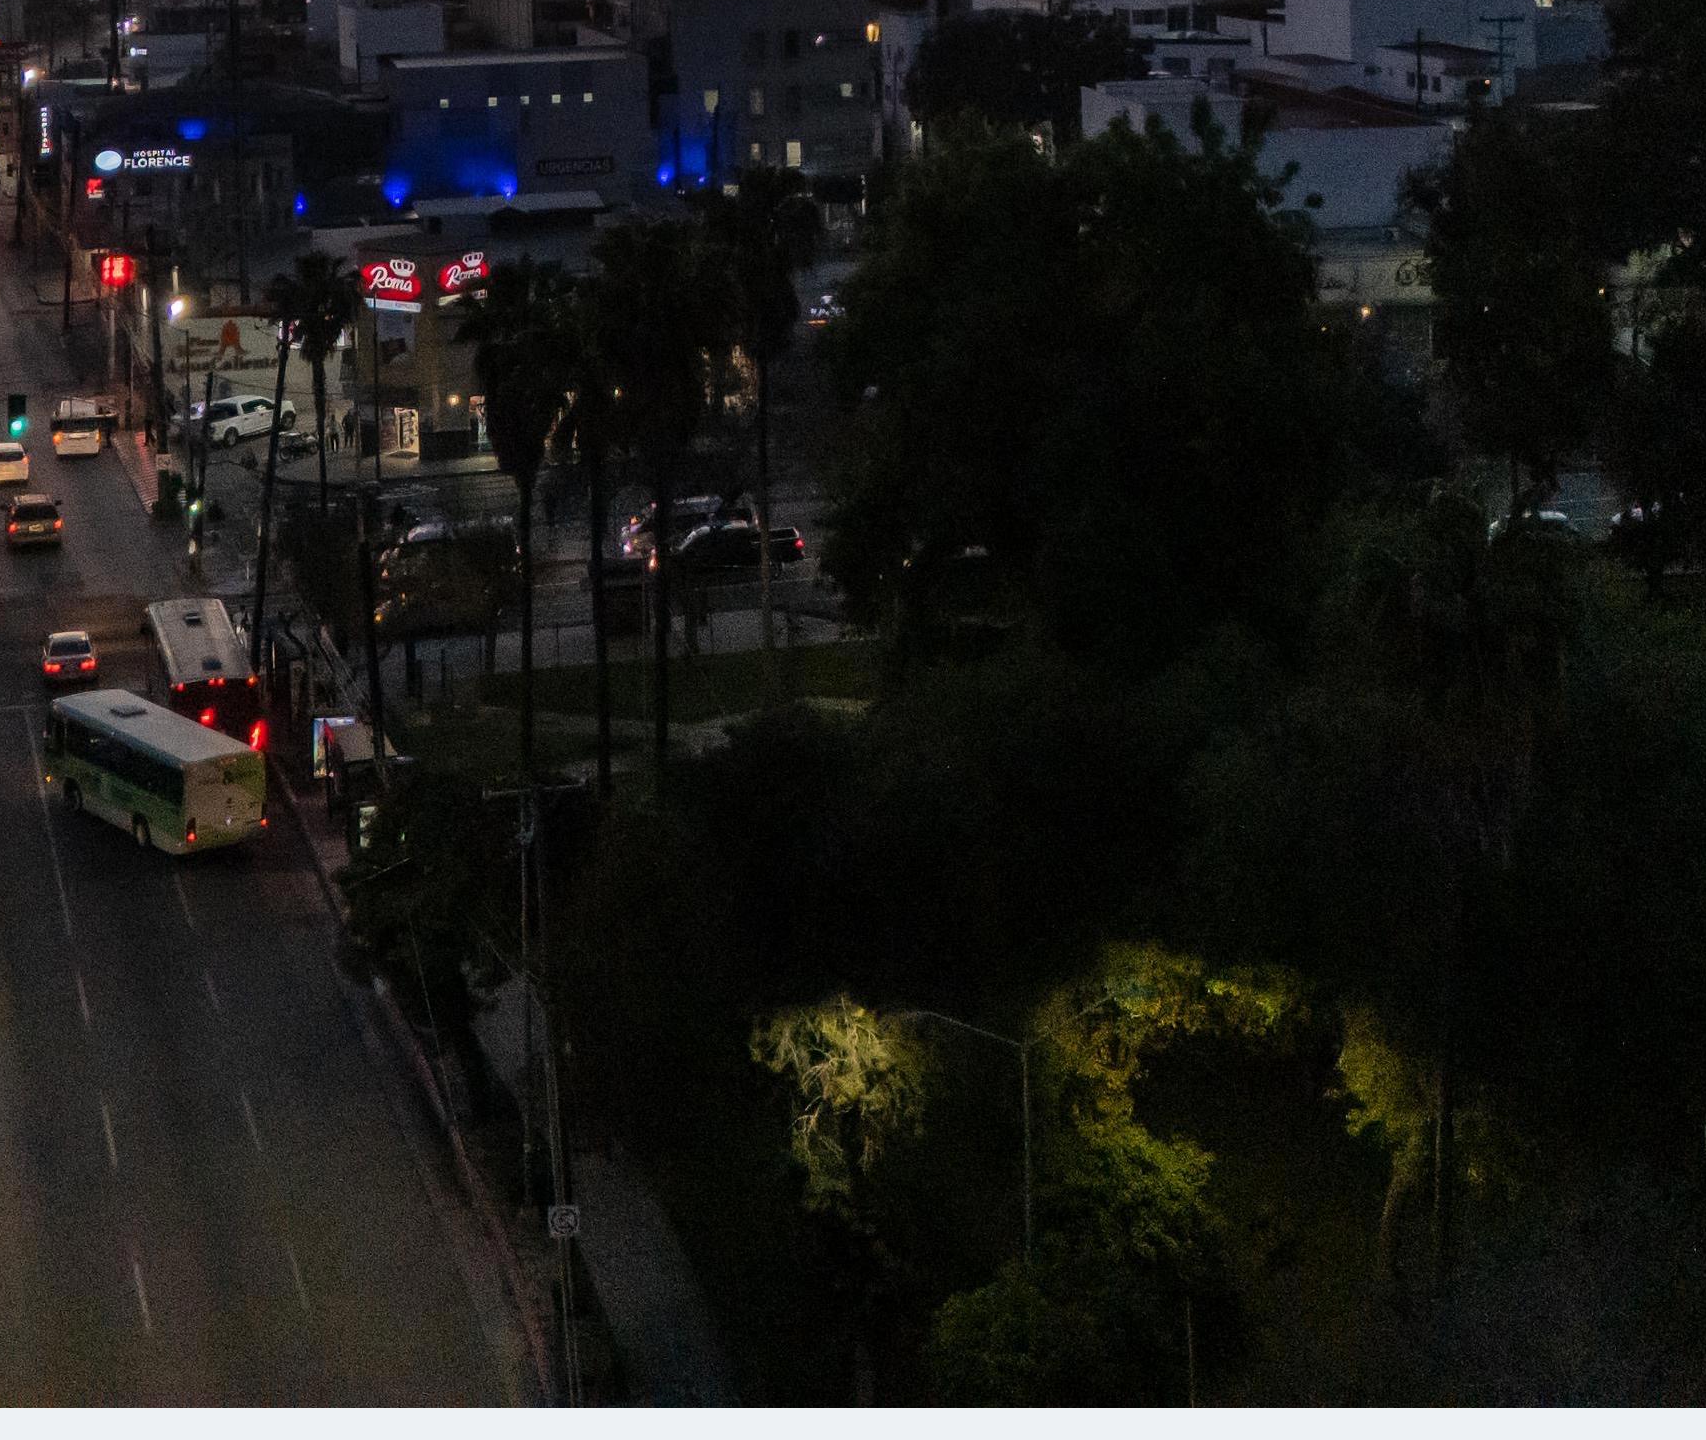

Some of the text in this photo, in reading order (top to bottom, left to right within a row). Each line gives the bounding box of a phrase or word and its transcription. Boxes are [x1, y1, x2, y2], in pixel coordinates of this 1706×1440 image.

[133, 149, 176, 157] HOSPITAL
[124, 156, 190, 169] FLORENCE
[539, 159, 611, 174] URGENCIAS
[369, 266, 413, 293] Roma
[446, 264, 482, 288] Roma
